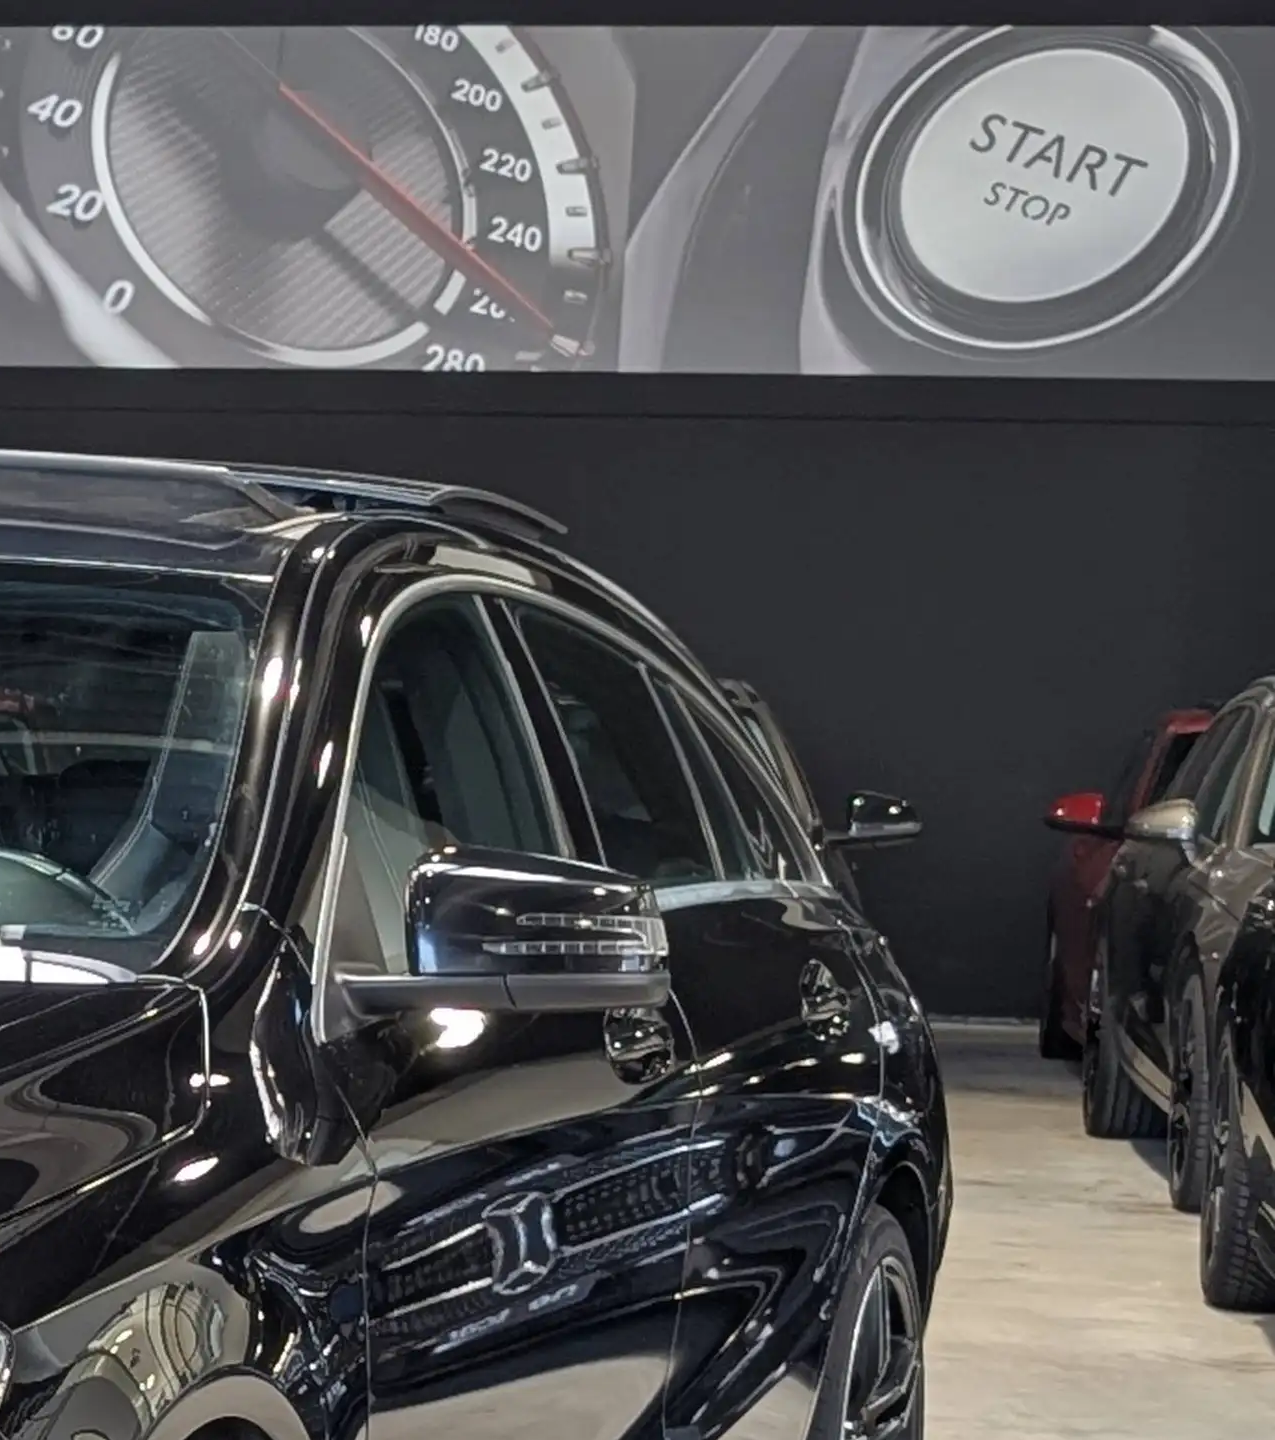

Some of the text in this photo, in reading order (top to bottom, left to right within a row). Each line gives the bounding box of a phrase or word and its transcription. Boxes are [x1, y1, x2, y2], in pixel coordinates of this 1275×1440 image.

[414, 25, 459, 52] 180
[27, 93, 83, 128] 40
[451, 77, 503, 112] 200
[479, 147, 533, 182] 220
[968, 113, 1149, 198] START
[46, 183, 104, 221] 20
[983, 181, 1071, 226] STOP
[487, 216, 542, 252] 240
[103, 279, 135, 314] 0
[422, 343, 486, 371] 280
